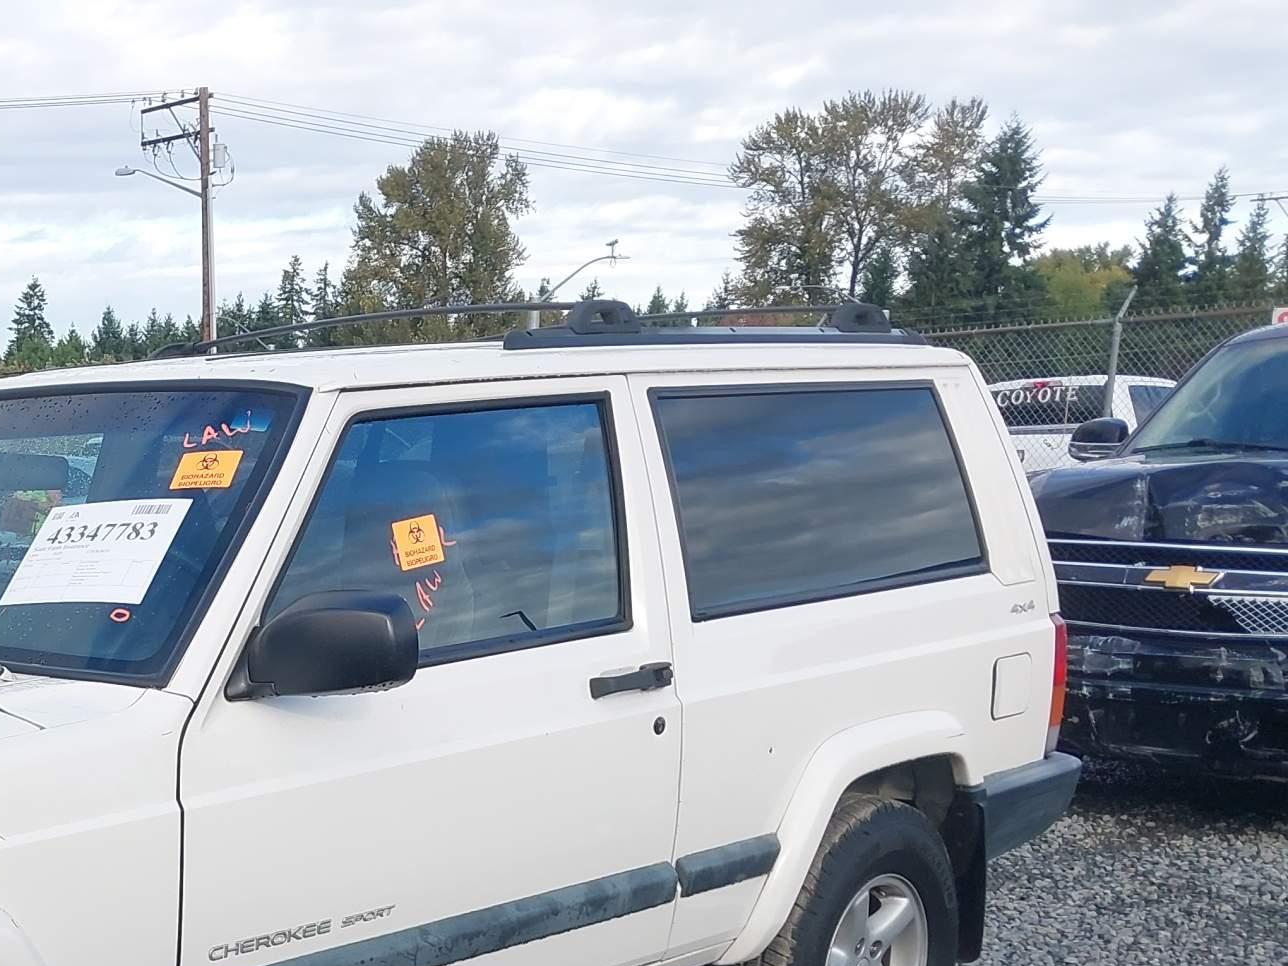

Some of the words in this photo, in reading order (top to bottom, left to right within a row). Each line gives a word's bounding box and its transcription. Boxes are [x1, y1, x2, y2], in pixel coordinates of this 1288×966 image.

[997, 386, 1079, 408] COYOTE
[183, 410, 251, 448] LAW
[181, 472, 225, 481] BIOHAZARD
[46, 521, 159, 545] 43347783
[404, 545, 436, 558] BIOHAZARD
[406, 553, 438, 567] BIOPELIGRO
[207, 918, 332, 962] CHEROKEE
[340, 904, 396, 929] SPORT
